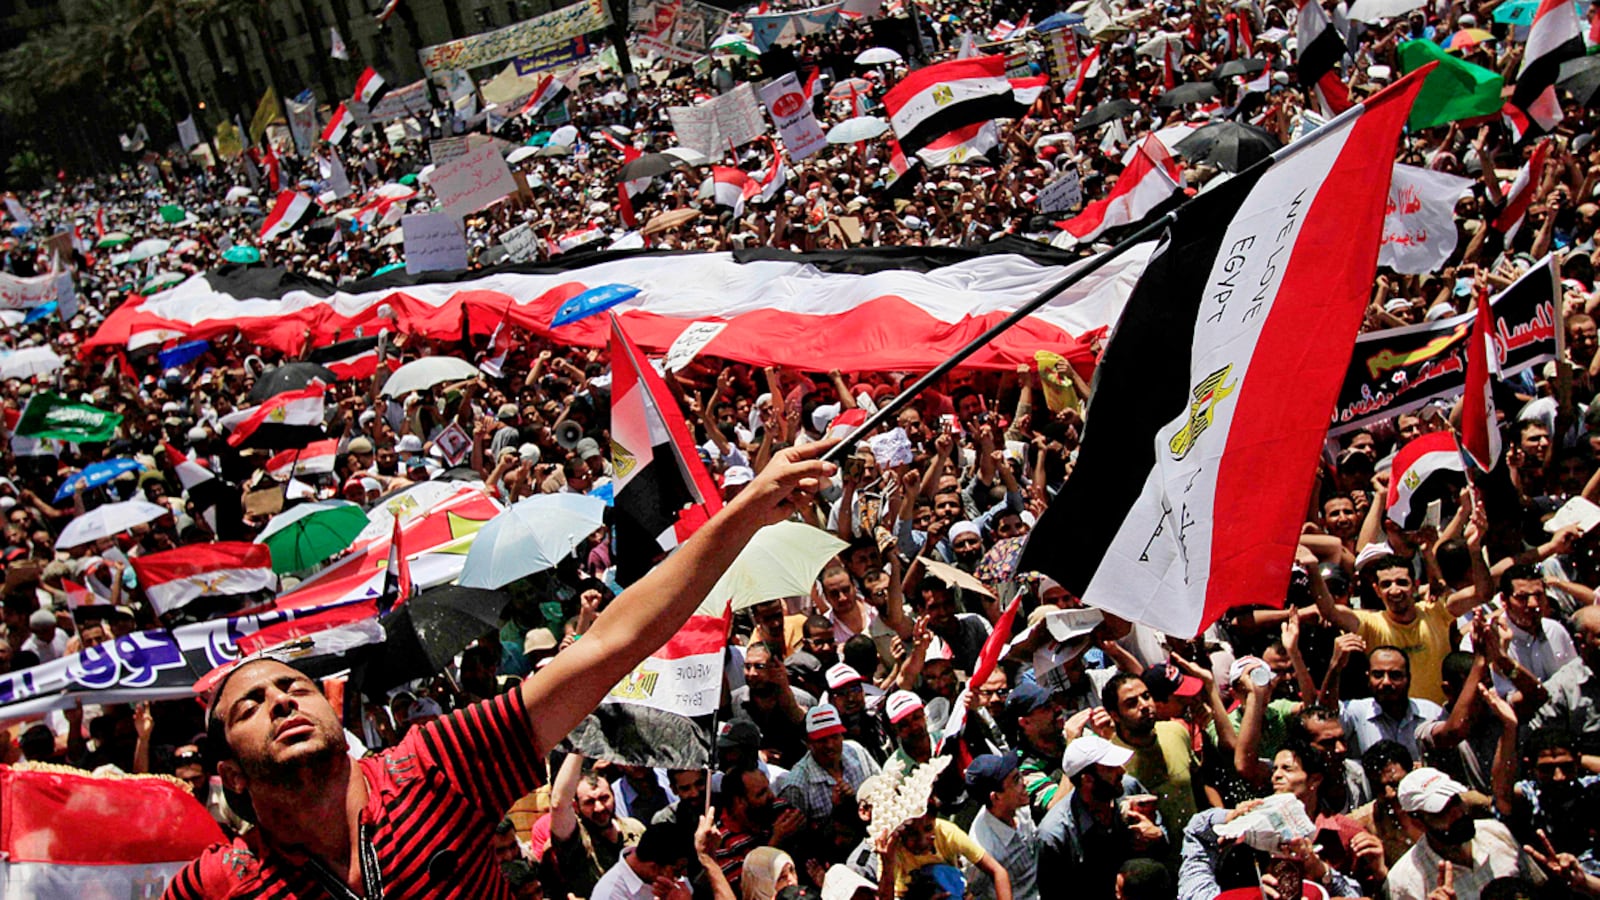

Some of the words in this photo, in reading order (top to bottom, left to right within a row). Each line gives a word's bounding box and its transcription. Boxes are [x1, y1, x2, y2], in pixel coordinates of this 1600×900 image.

[1275, 187, 1307, 243] WE
[1207, 235, 1256, 324] EGYPT
[1242, 245, 1285, 323] LOVE
[1138, 500, 1172, 562] مصر
